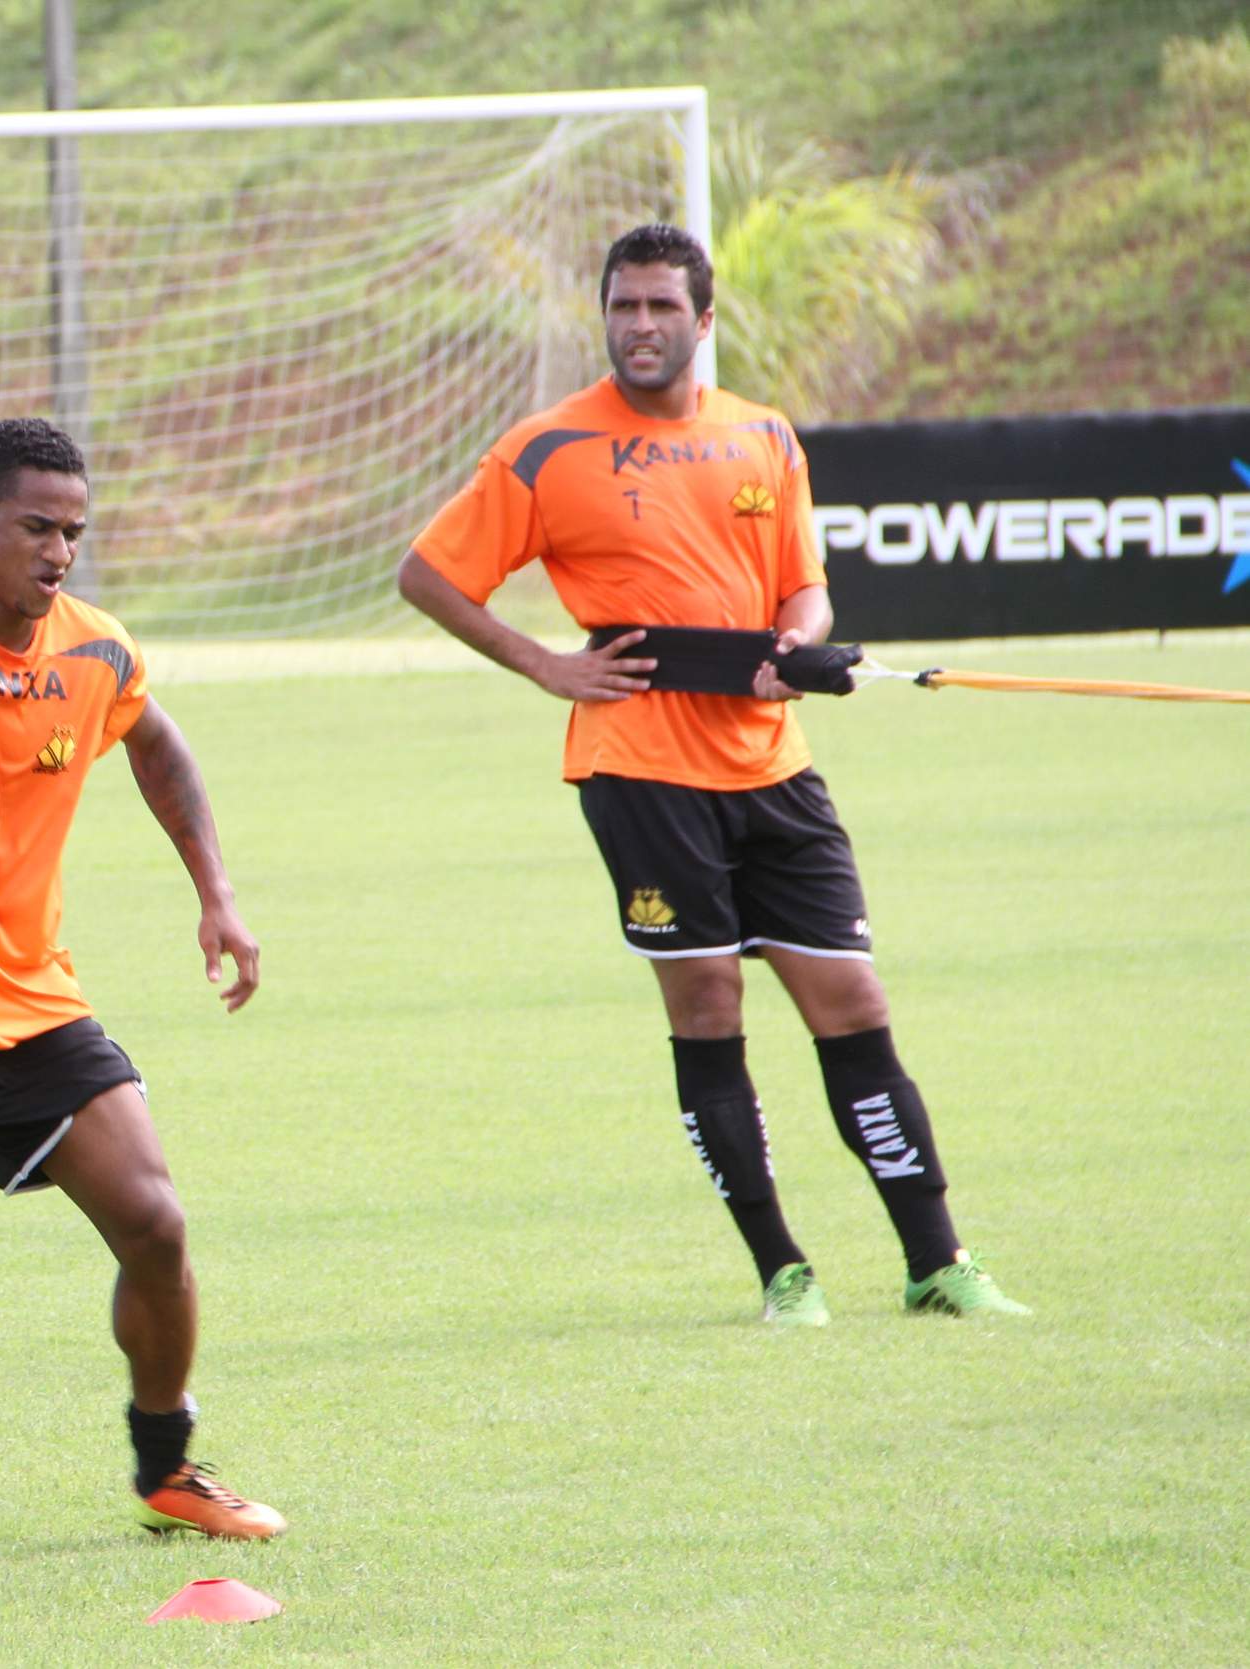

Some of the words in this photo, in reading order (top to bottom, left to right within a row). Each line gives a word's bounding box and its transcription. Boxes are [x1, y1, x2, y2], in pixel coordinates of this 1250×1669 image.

[611, 436, 746, 475] KANXA
[813, 493, 1250, 565] POWERADE
[853, 1092, 924, 1178] KANXA
